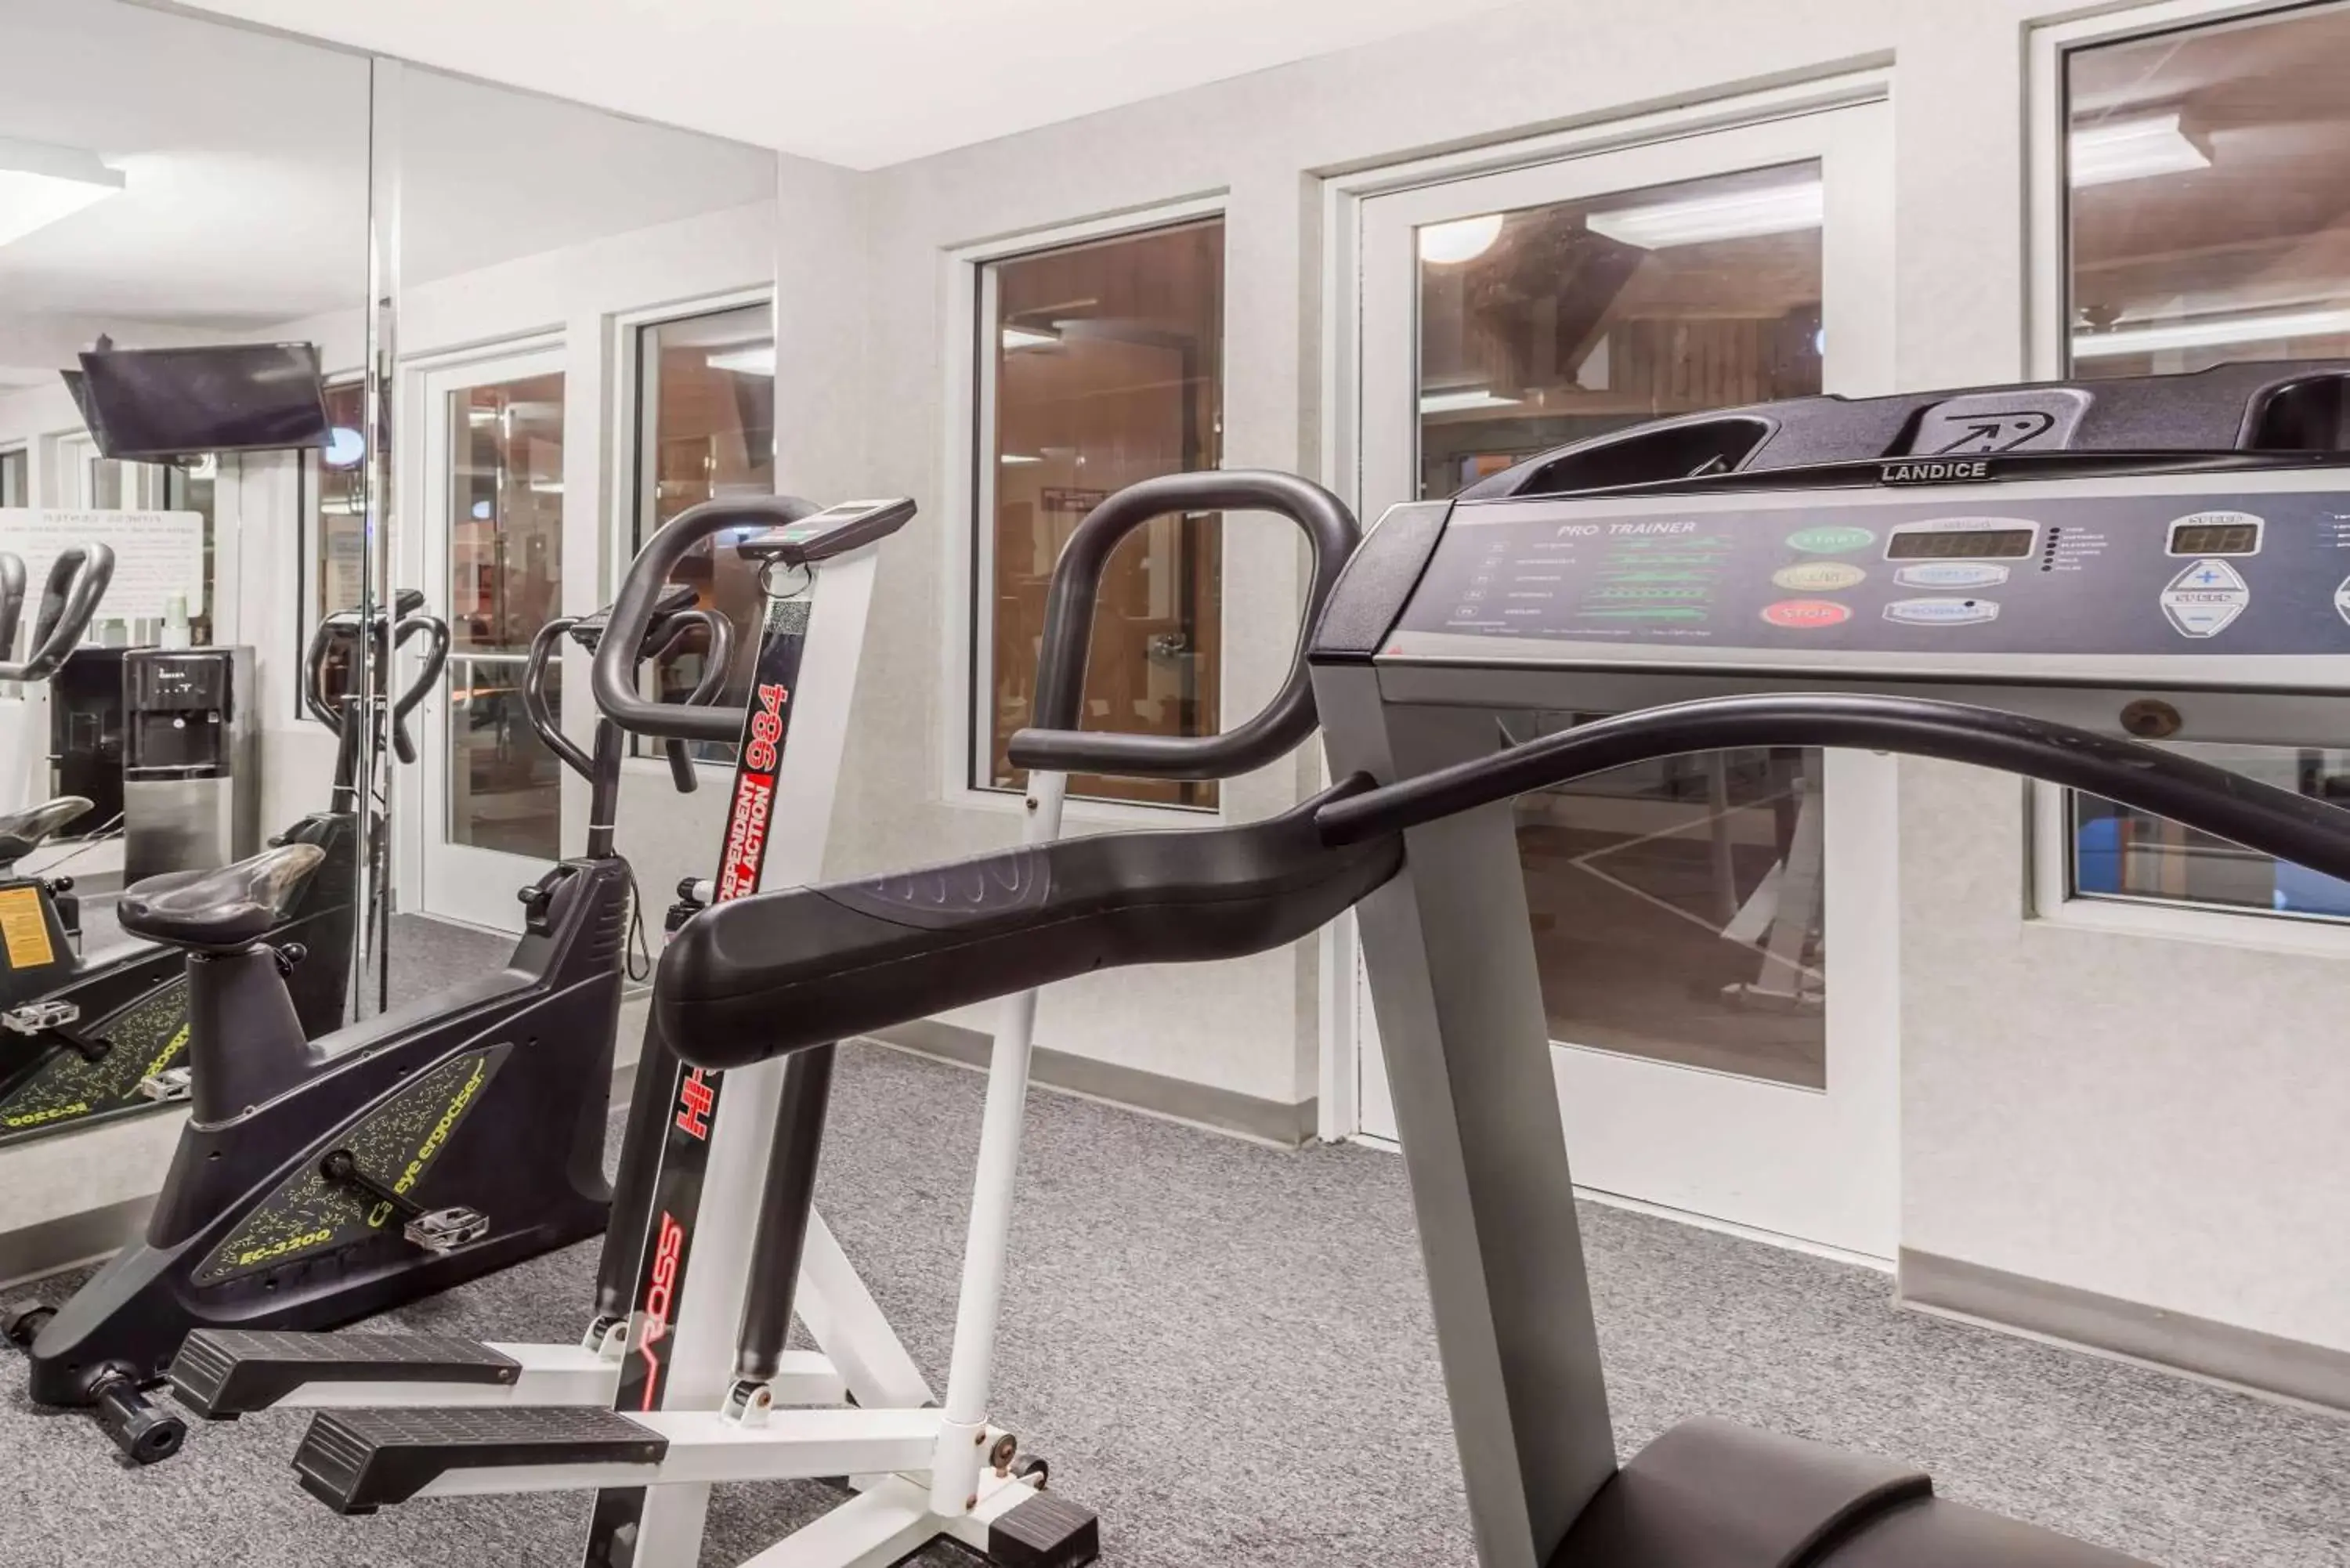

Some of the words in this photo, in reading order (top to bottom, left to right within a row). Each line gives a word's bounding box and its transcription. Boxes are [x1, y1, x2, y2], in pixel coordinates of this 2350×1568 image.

[1882, 462, 1987, 482] LANDICE
[1556, 524, 1600, 537] PRO
[1608, 521, 1697, 535] TRAINER
[746, 684, 789, 771] 984
[718, 773, 755, 902] DEPENDENT
[742, 786, 772, 875] ACTION
[239, 1229, 331, 1265] EC-3200
[639, 1210, 683, 1411] ROSS
